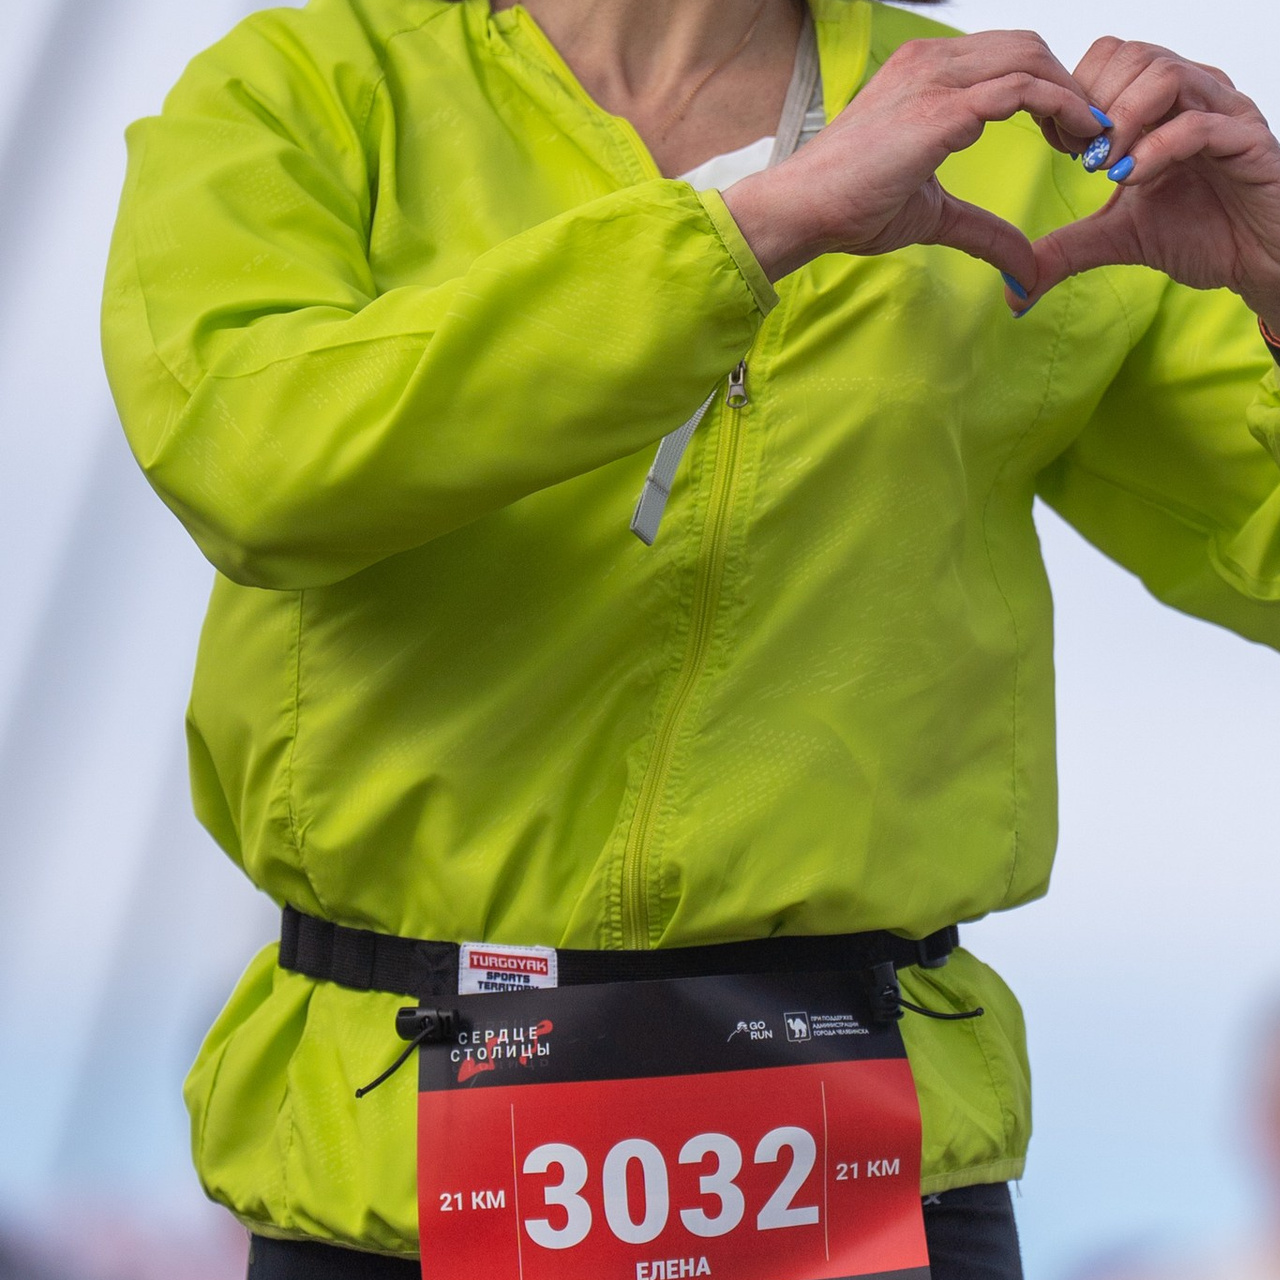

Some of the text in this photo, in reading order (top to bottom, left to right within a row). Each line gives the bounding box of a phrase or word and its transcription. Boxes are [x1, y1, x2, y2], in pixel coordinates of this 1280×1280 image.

[471, 954, 547, 972] TURGOYAK
[486, 971, 531, 983] SPORTS
[750, 1021, 765, 1030] GO
[750, 1029, 773, 1040] RUN
[458, 1026, 538, 1045] СЕРДЦЕ
[450, 1042, 550, 1062] СТОЛИЦЫ
[836, 1162, 859, 1181] 21
[522, 1126, 819, 1250] 3032
[439, 1192, 463, 1211] 21
